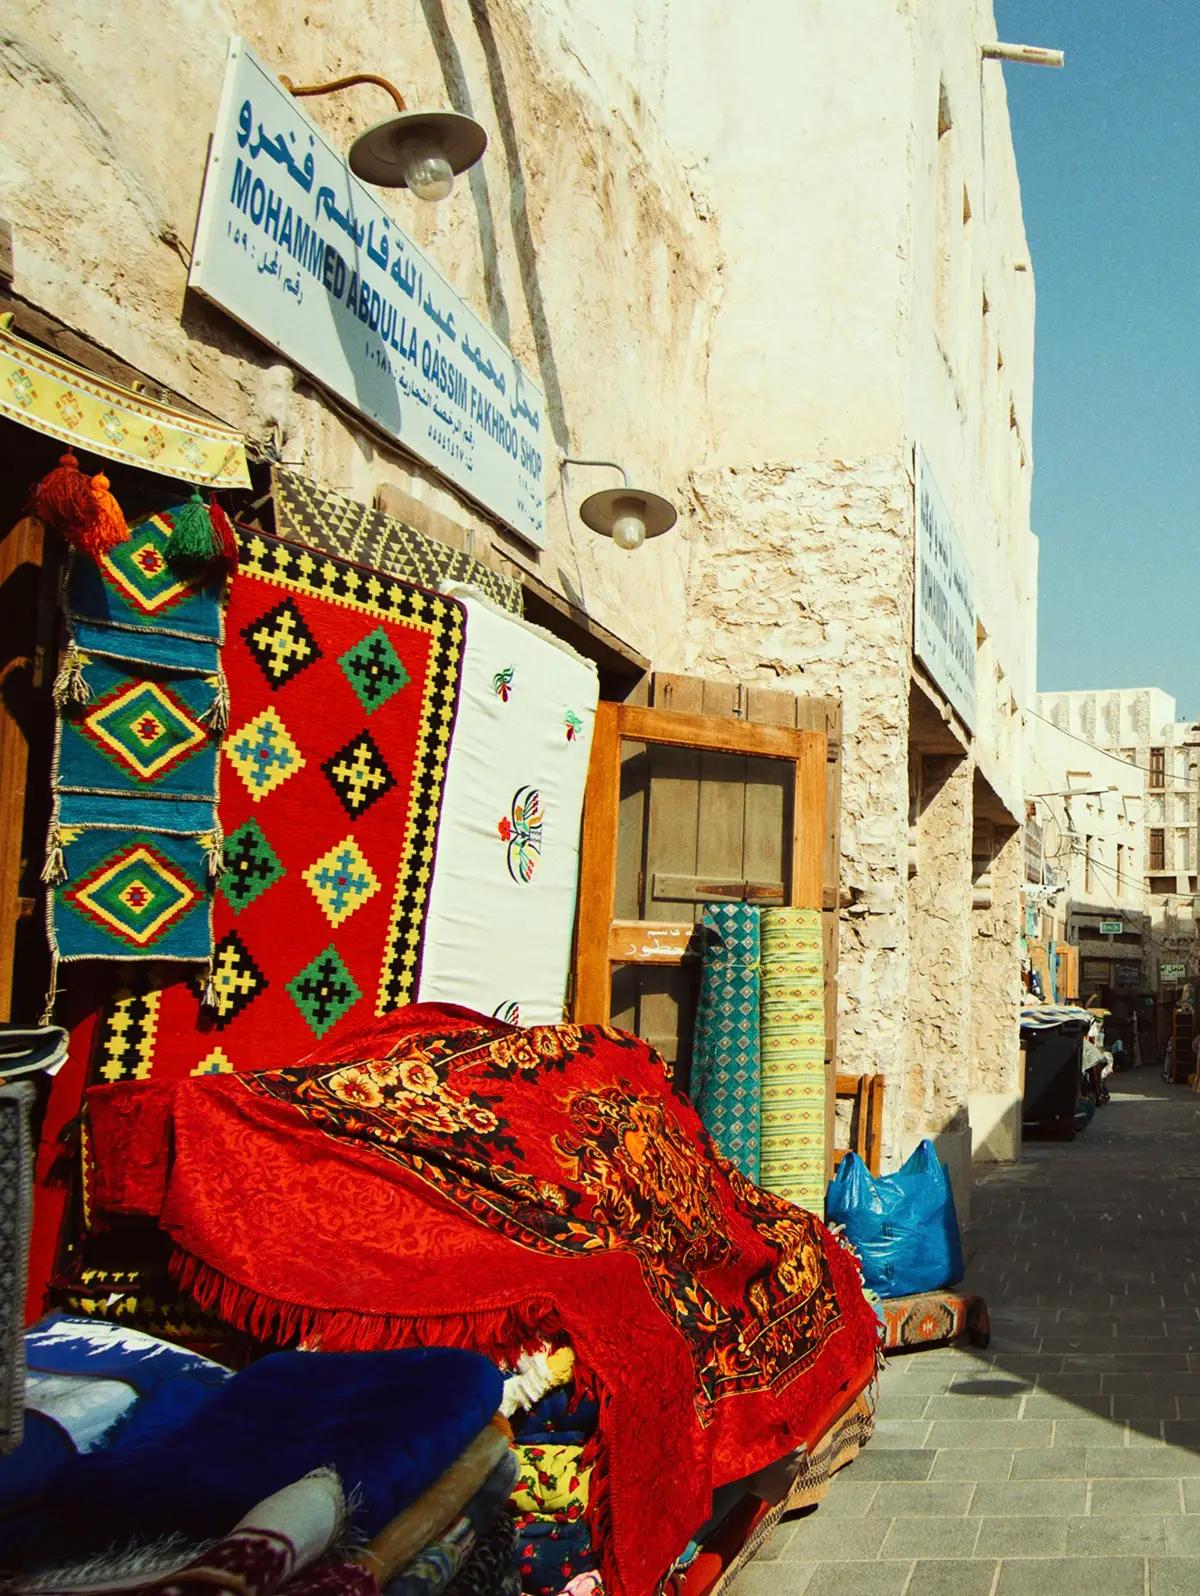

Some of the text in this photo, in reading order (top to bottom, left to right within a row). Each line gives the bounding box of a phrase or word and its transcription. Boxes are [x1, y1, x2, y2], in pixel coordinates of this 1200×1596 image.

[237, 100, 315, 194] فخرو
[227, 220, 248, 251] ١٥٩
[315, 186, 390, 271] قاسم
[282, 271, 304, 305] رقم
[230, 157, 542, 482] MOHAMMED ABDULLA QASSIM FAKHROO SHOP
[461, 333, 506, 396] محمد
[433, 395, 462, 434] الرخصة
[510, 374, 540, 433] محل
